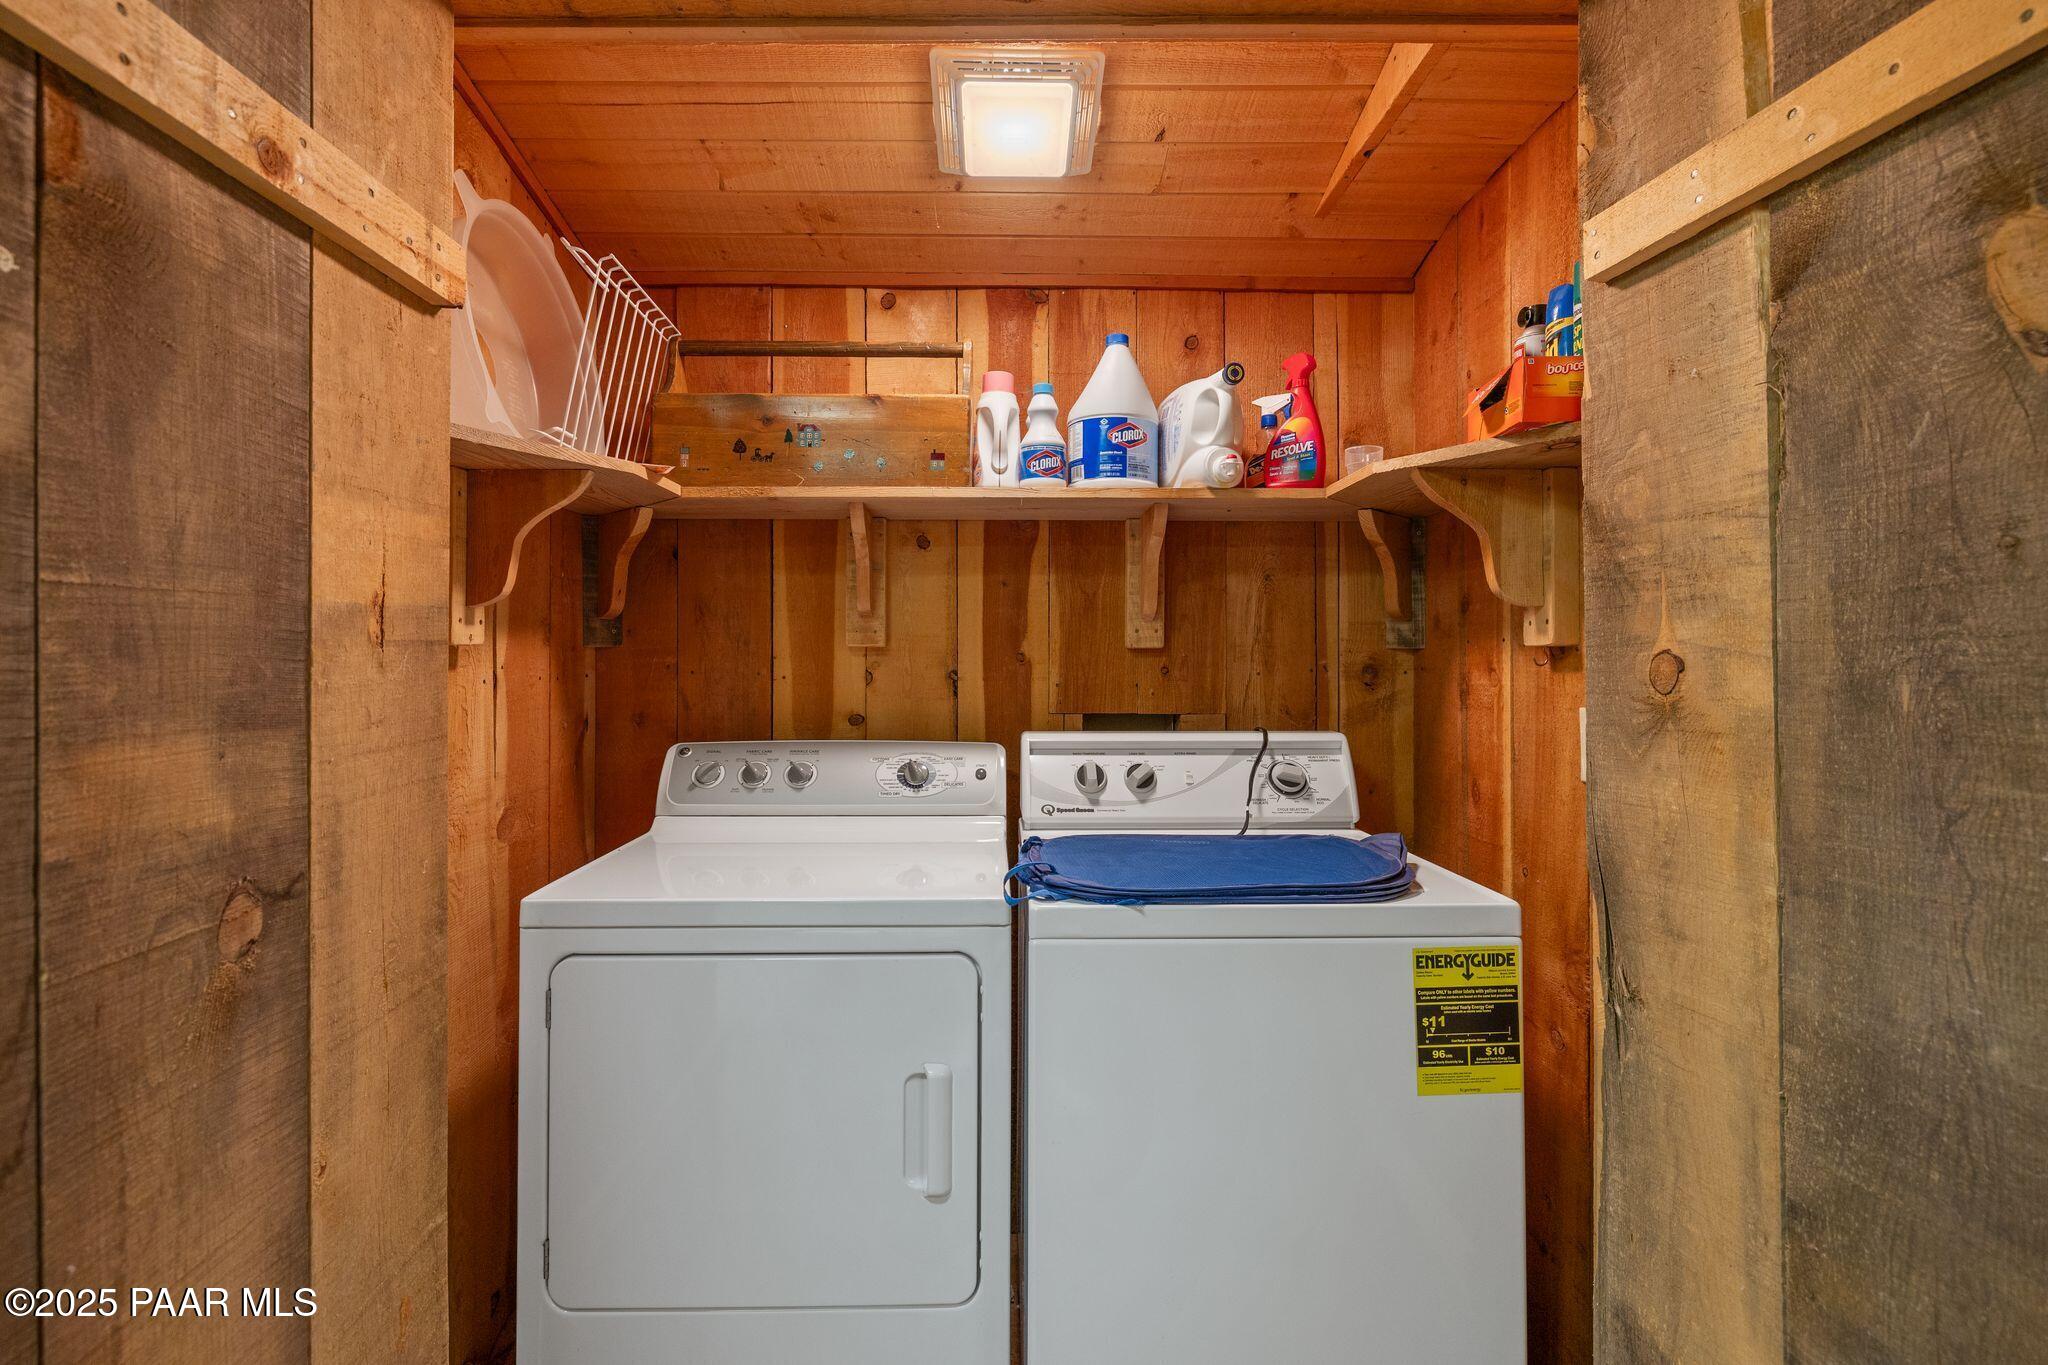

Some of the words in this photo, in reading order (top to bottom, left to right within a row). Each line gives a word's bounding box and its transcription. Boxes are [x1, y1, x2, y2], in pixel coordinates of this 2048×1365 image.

[1547, 362, 1584, 375] bounce
[1113, 429, 1145, 444] CLOROX
[1271, 441, 1315, 460] RESOLVE
[1030, 456, 1060, 472] CLOROX
[1416, 953, 1516, 970] ENERGYGUIDE
[1422, 1016, 1446, 1027] $11
[1432, 1050, 1446, 1058] 96
[1485, 1046, 1505, 1056] $10
